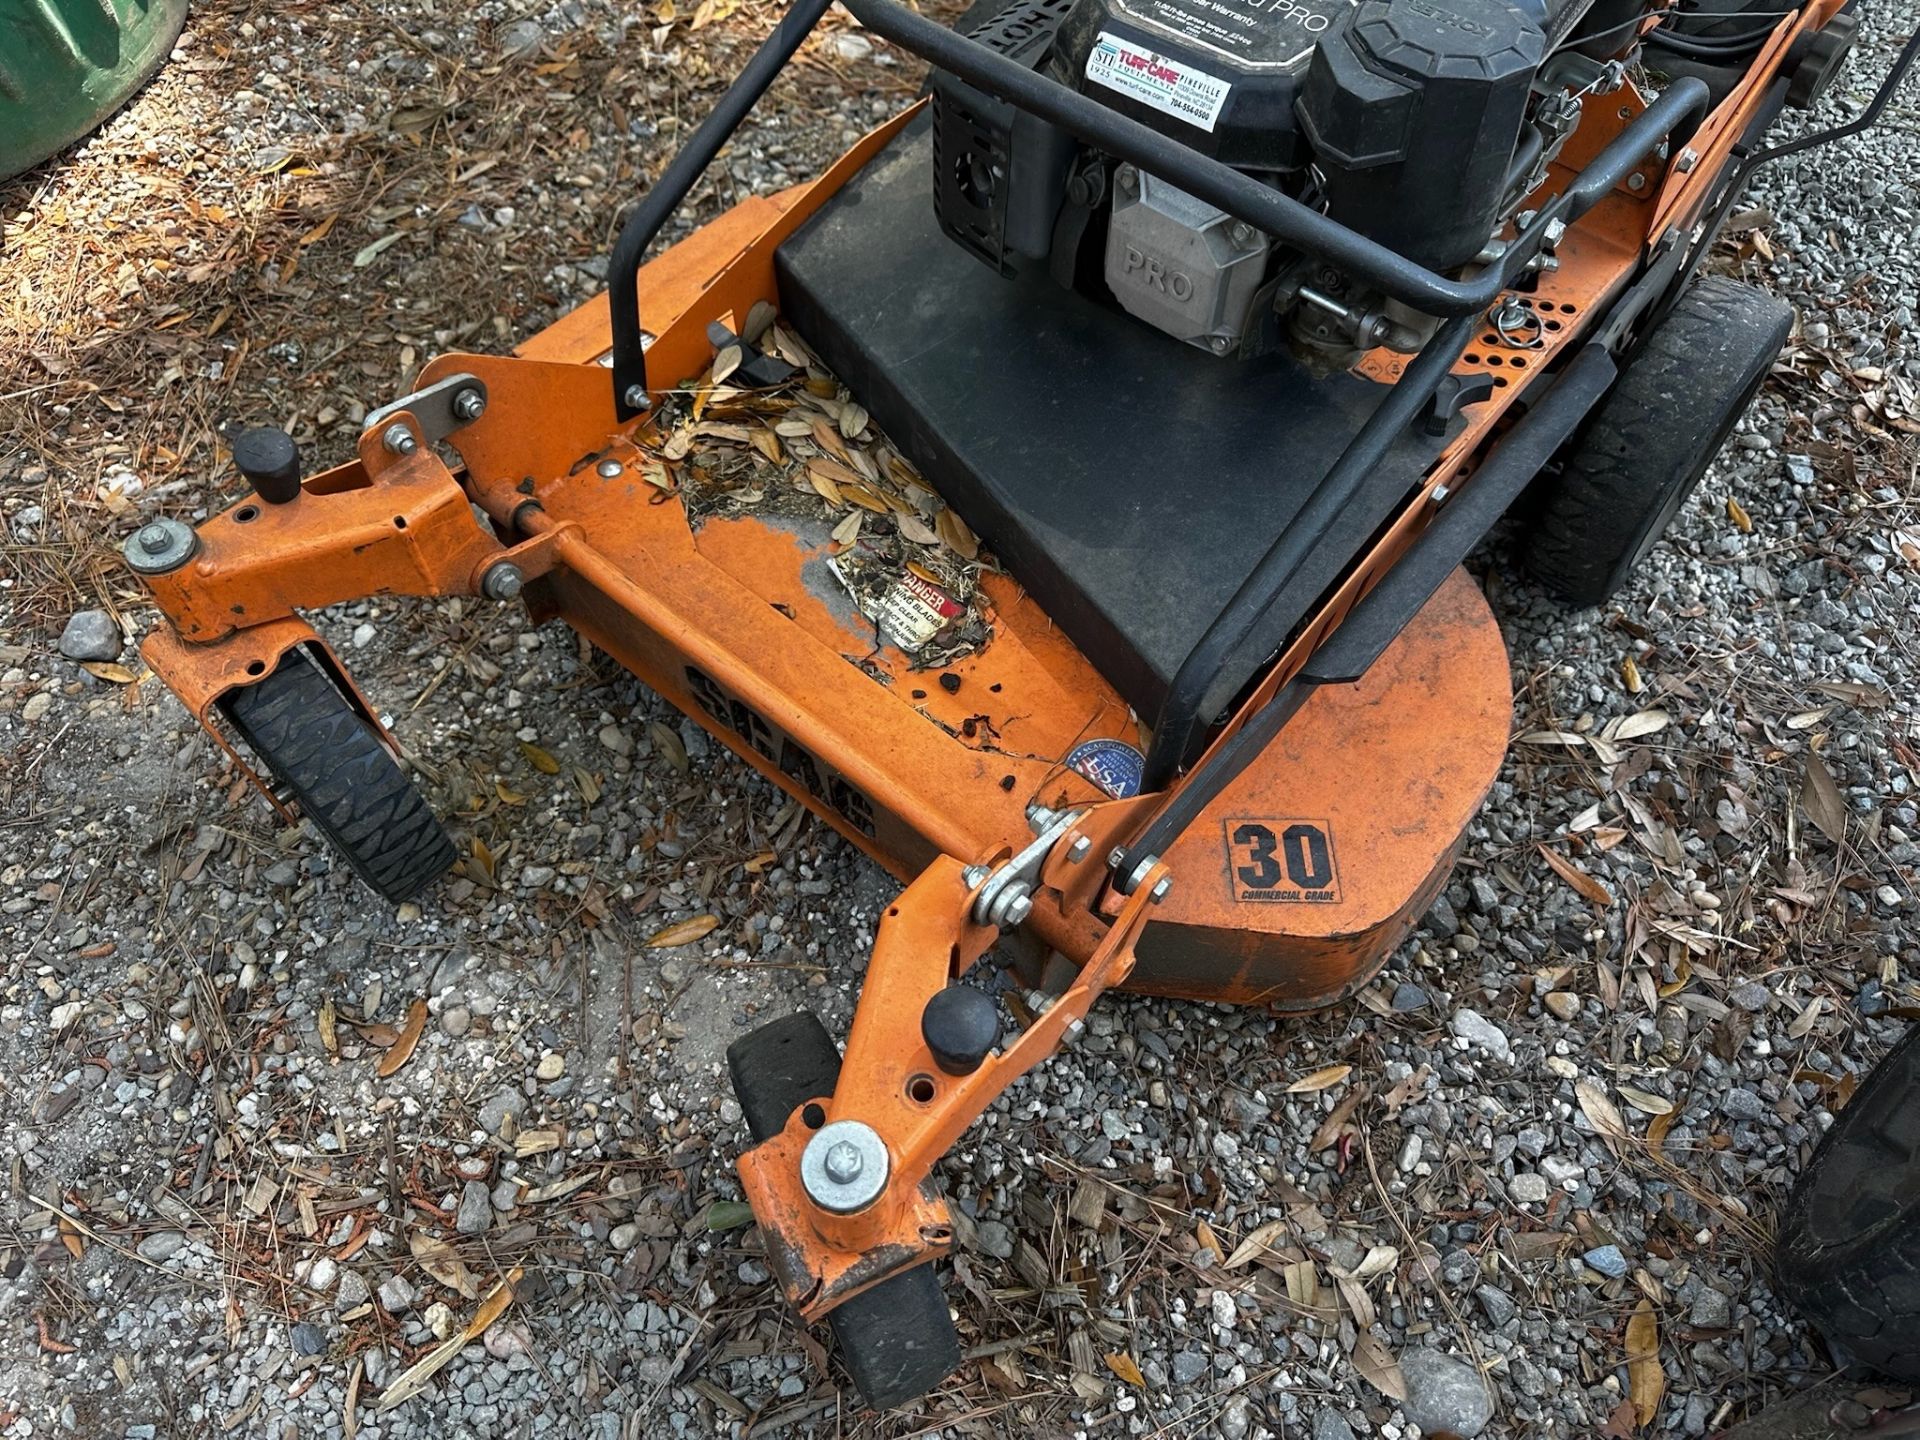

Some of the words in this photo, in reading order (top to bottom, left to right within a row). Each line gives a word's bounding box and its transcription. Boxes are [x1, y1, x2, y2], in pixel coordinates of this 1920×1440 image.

[1211, 2, 1257, 26] Warranty
[1268, 0, 1328, 31] PRO
[1206, 22, 1228, 34] torque
[1096, 51, 1114, 67] STI
[1090, 64, 1110, 78] 1925
[1115, 77, 1165, 101] www.turf-care.com
[1180, 75, 1220, 97] PINEVILLE
[1123, 244, 1194, 303] PRO
[902, 570, 944, 611] DANGER
[899, 607, 918, 623] CLEAR
[913, 604, 942, 627] BLADES
[684, 664, 876, 838] SCAG
[1082, 743, 1104, 751] SCAG
[1088, 757, 1126, 798] USA
[1233, 824, 1333, 889] 30
[1241, 890, 1300, 900] COMMERCIAL
[1305, 890, 1335, 901] GRADE
